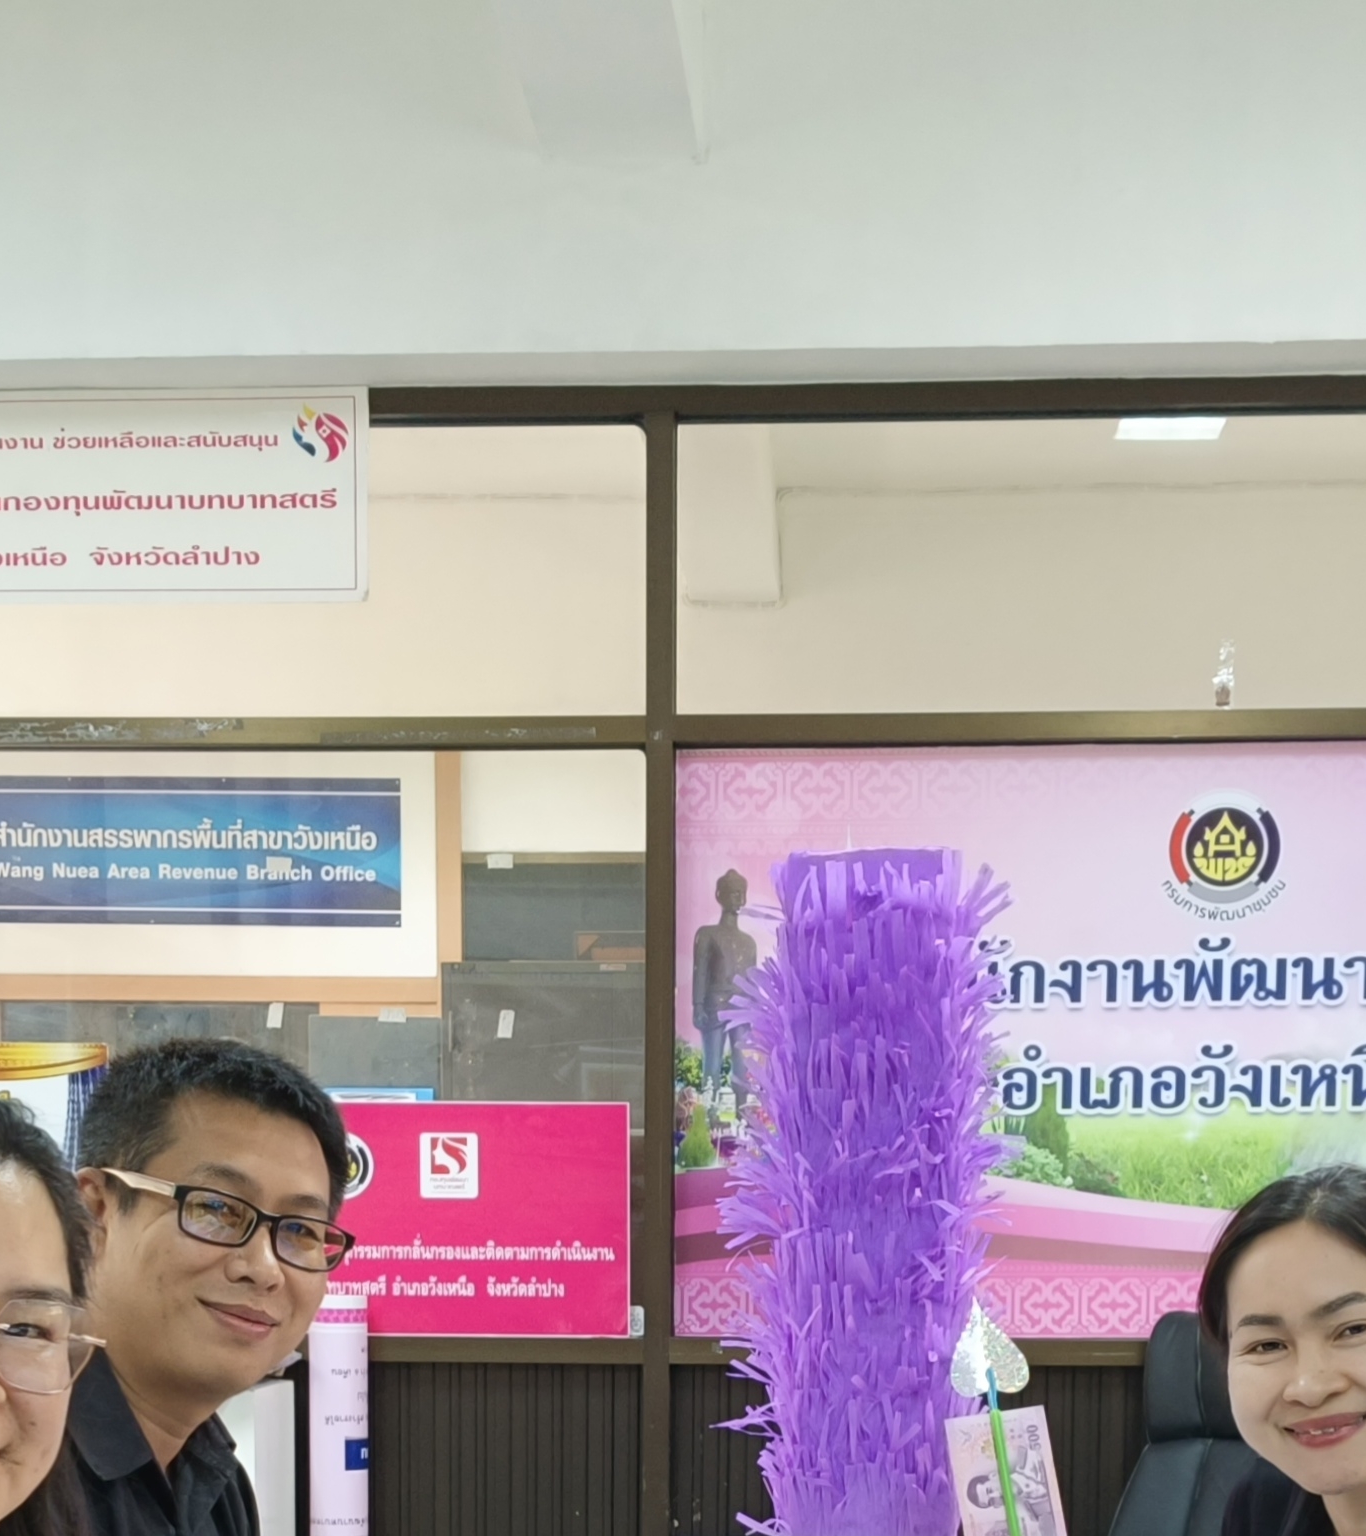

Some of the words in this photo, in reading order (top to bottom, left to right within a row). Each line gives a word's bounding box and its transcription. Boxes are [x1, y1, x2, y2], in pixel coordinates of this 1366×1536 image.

[52, 427, 280, 452] ช่วยเหลือและสนับสนุน
[89, 546, 261, 568] จังหวัดลำปาง
[52, 862, 100, 880] Nuea
[107, 863, 151, 880] Area
[158, 864, 238, 881] Revenue
[320, 864, 377, 882] Office
[1161, 879, 1287, 921] กรมการพัฒนาชุมชน
[392, 1275, 476, 1296] อำเภอวังเหนือ
[487, 1276, 565, 1297] จังหวัดลำปาง
